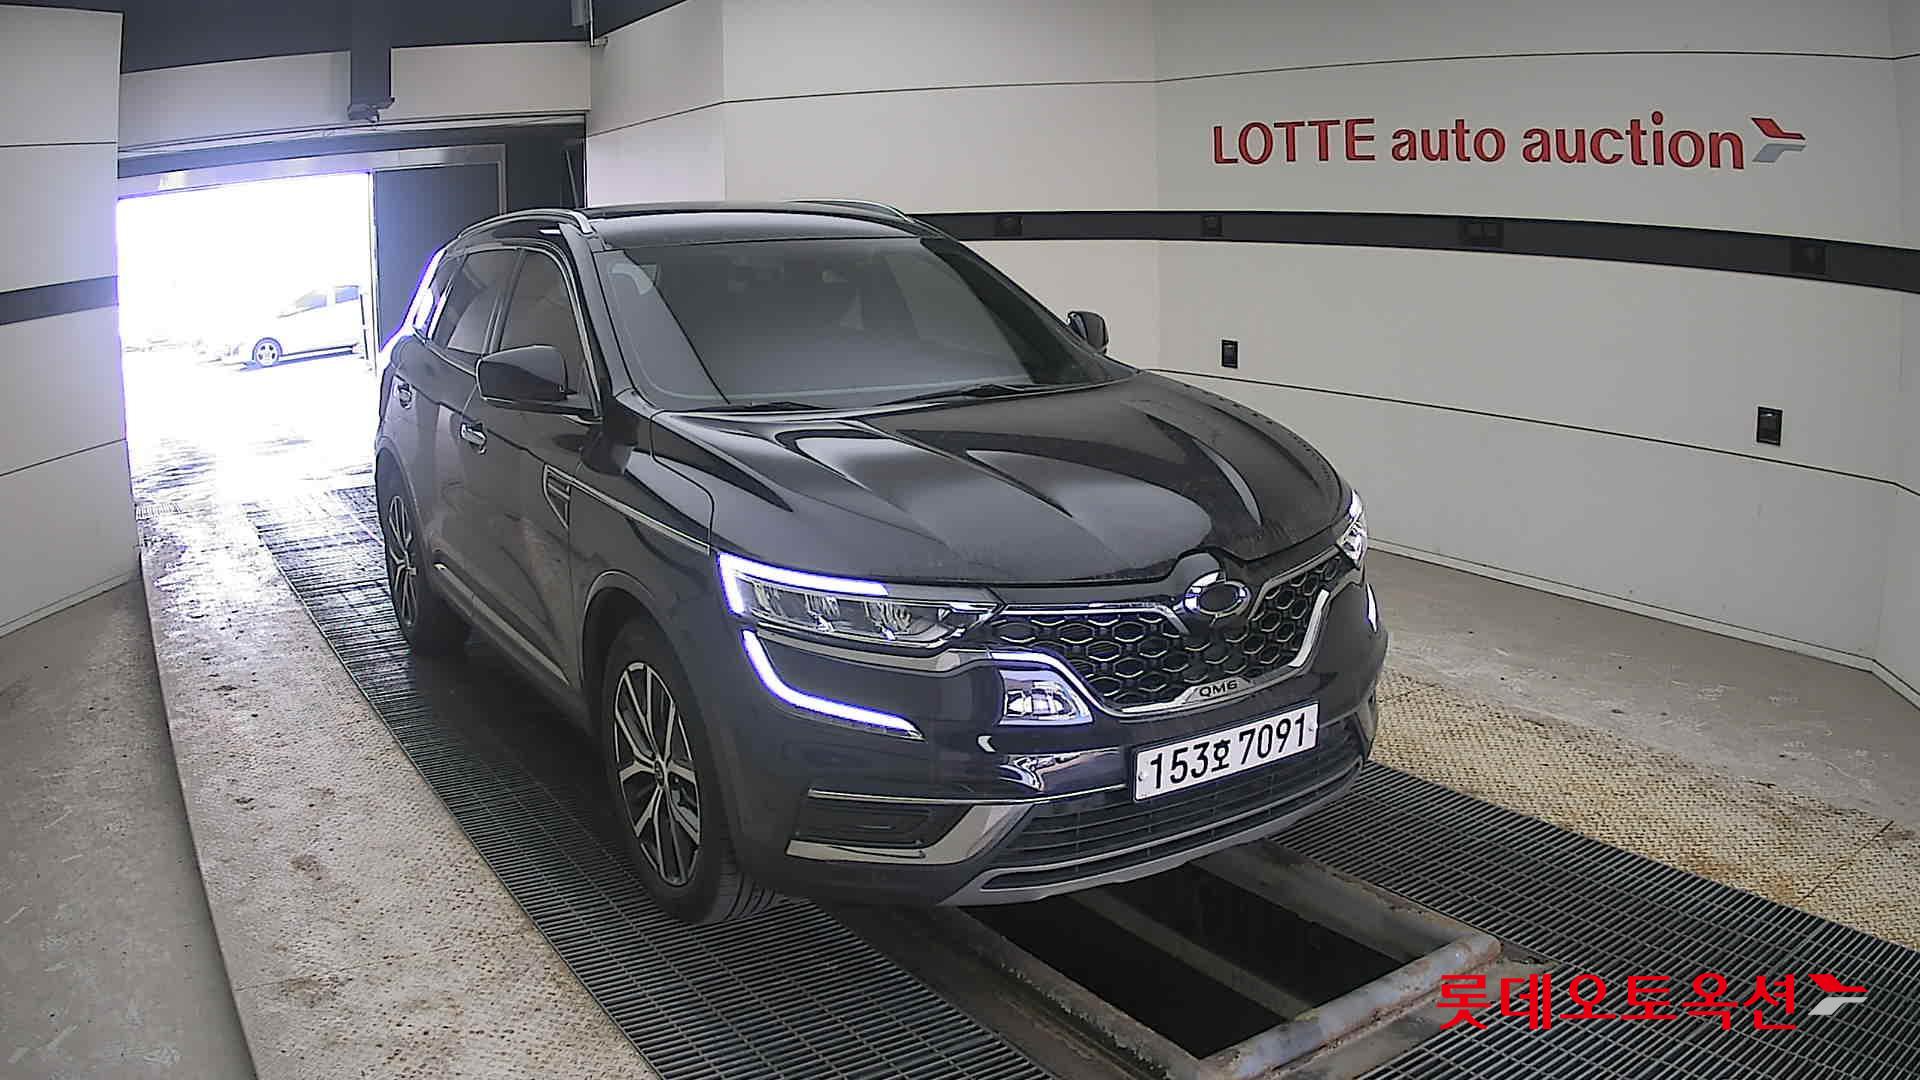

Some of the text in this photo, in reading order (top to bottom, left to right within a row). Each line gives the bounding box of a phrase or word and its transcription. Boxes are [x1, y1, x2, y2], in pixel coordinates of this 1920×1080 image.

[1213, 111, 1746, 170] LOTTE auto auction
[1200, 680, 1237, 697] QM6
[1239, 712, 1306, 765] 7091
